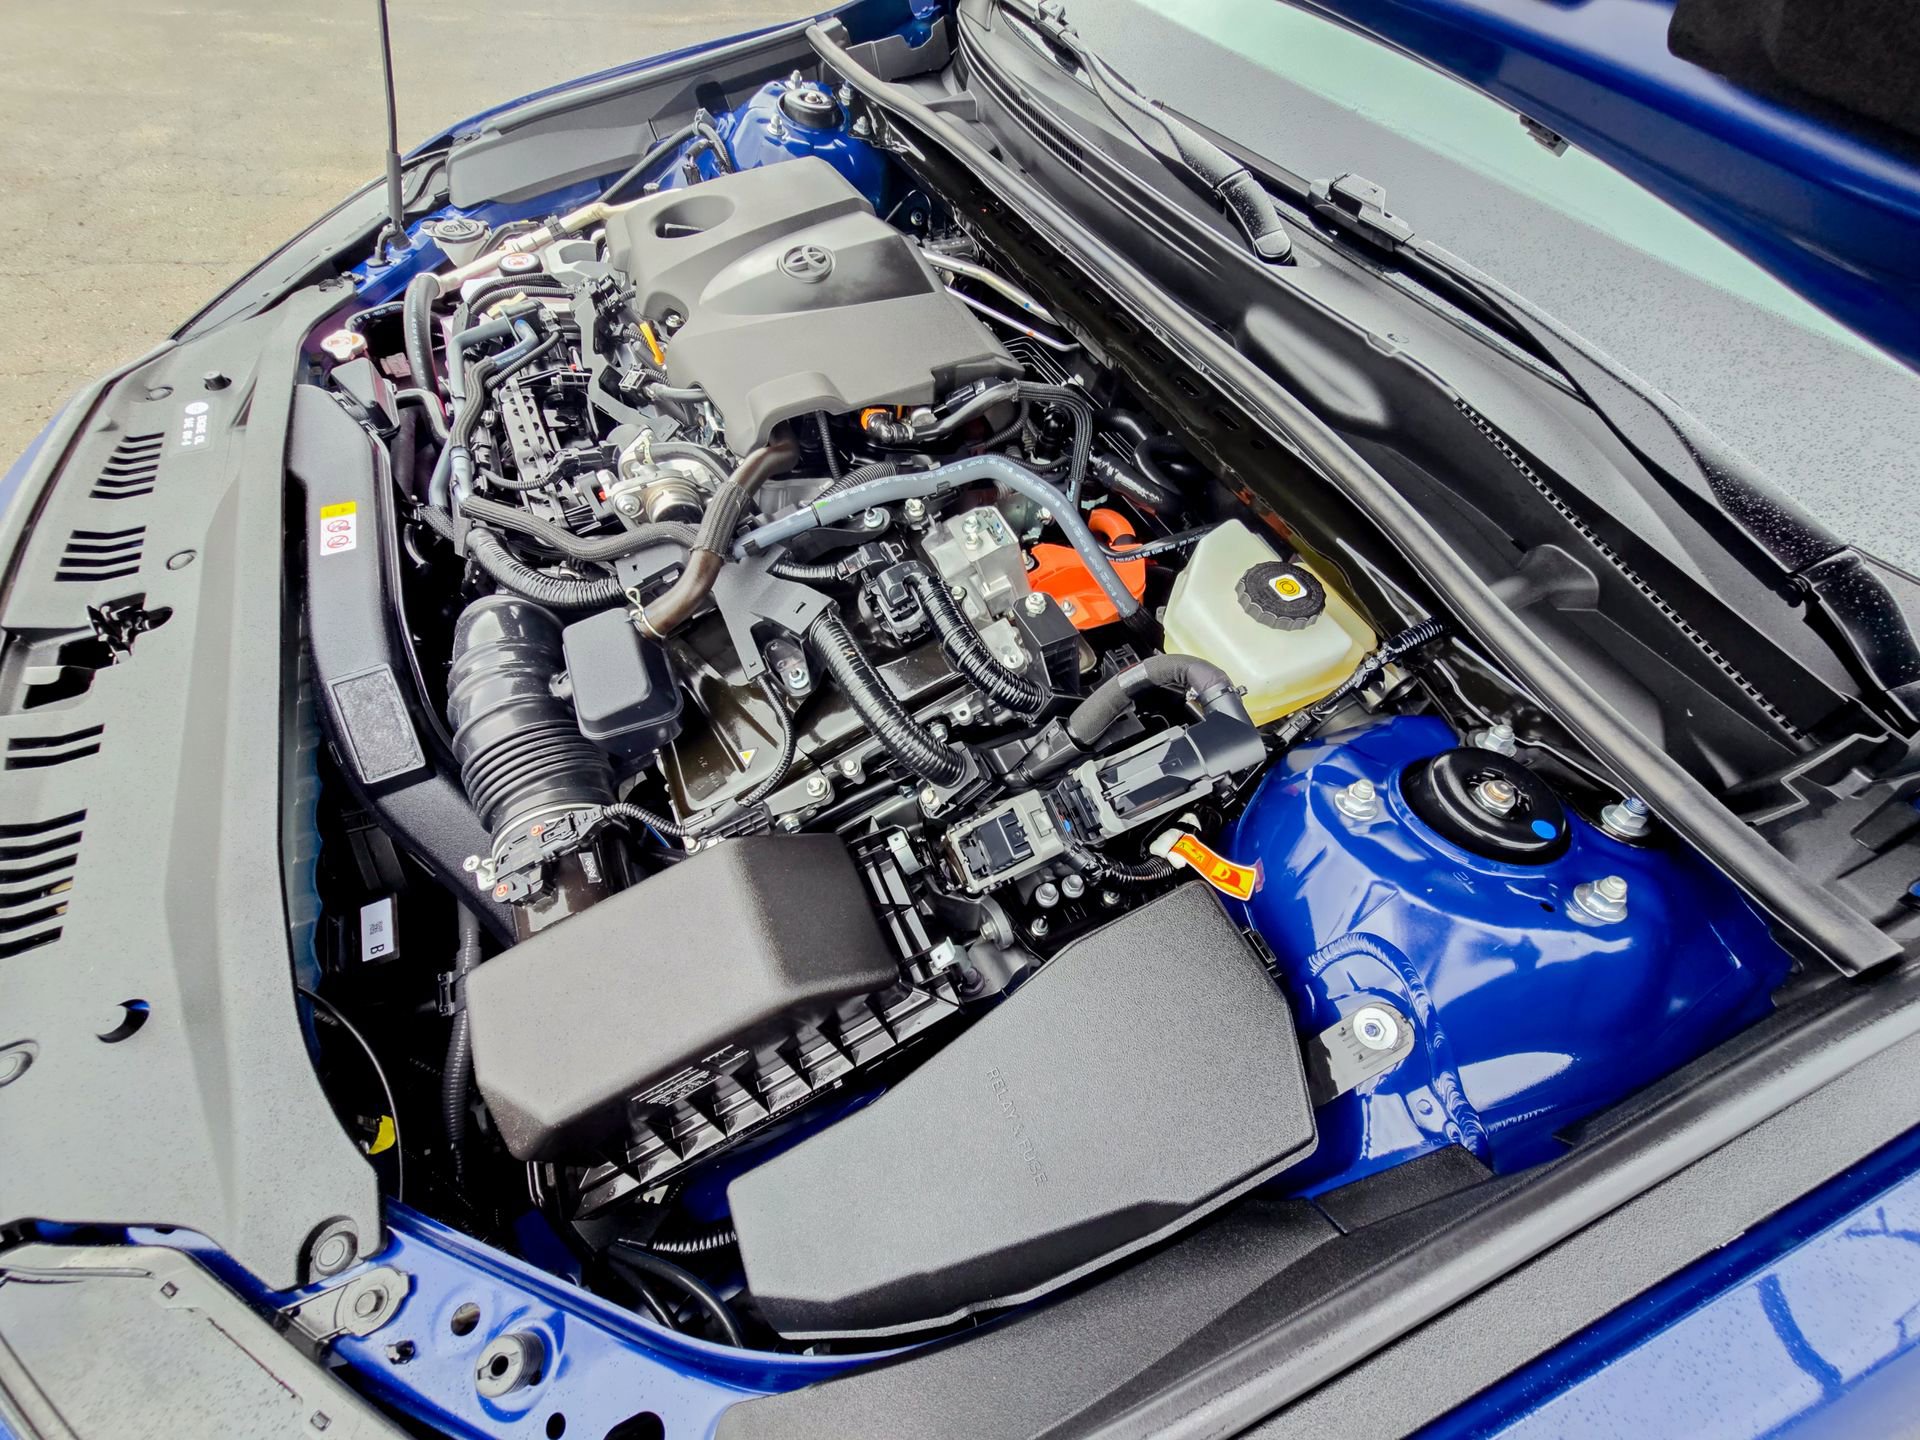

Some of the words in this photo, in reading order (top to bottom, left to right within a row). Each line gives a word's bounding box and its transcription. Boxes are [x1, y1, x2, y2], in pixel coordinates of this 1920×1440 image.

[370, 944, 384, 954] B
[986, 1066, 1020, 1119] RELAY
[1019, 1137, 1048, 1187] FUSE
